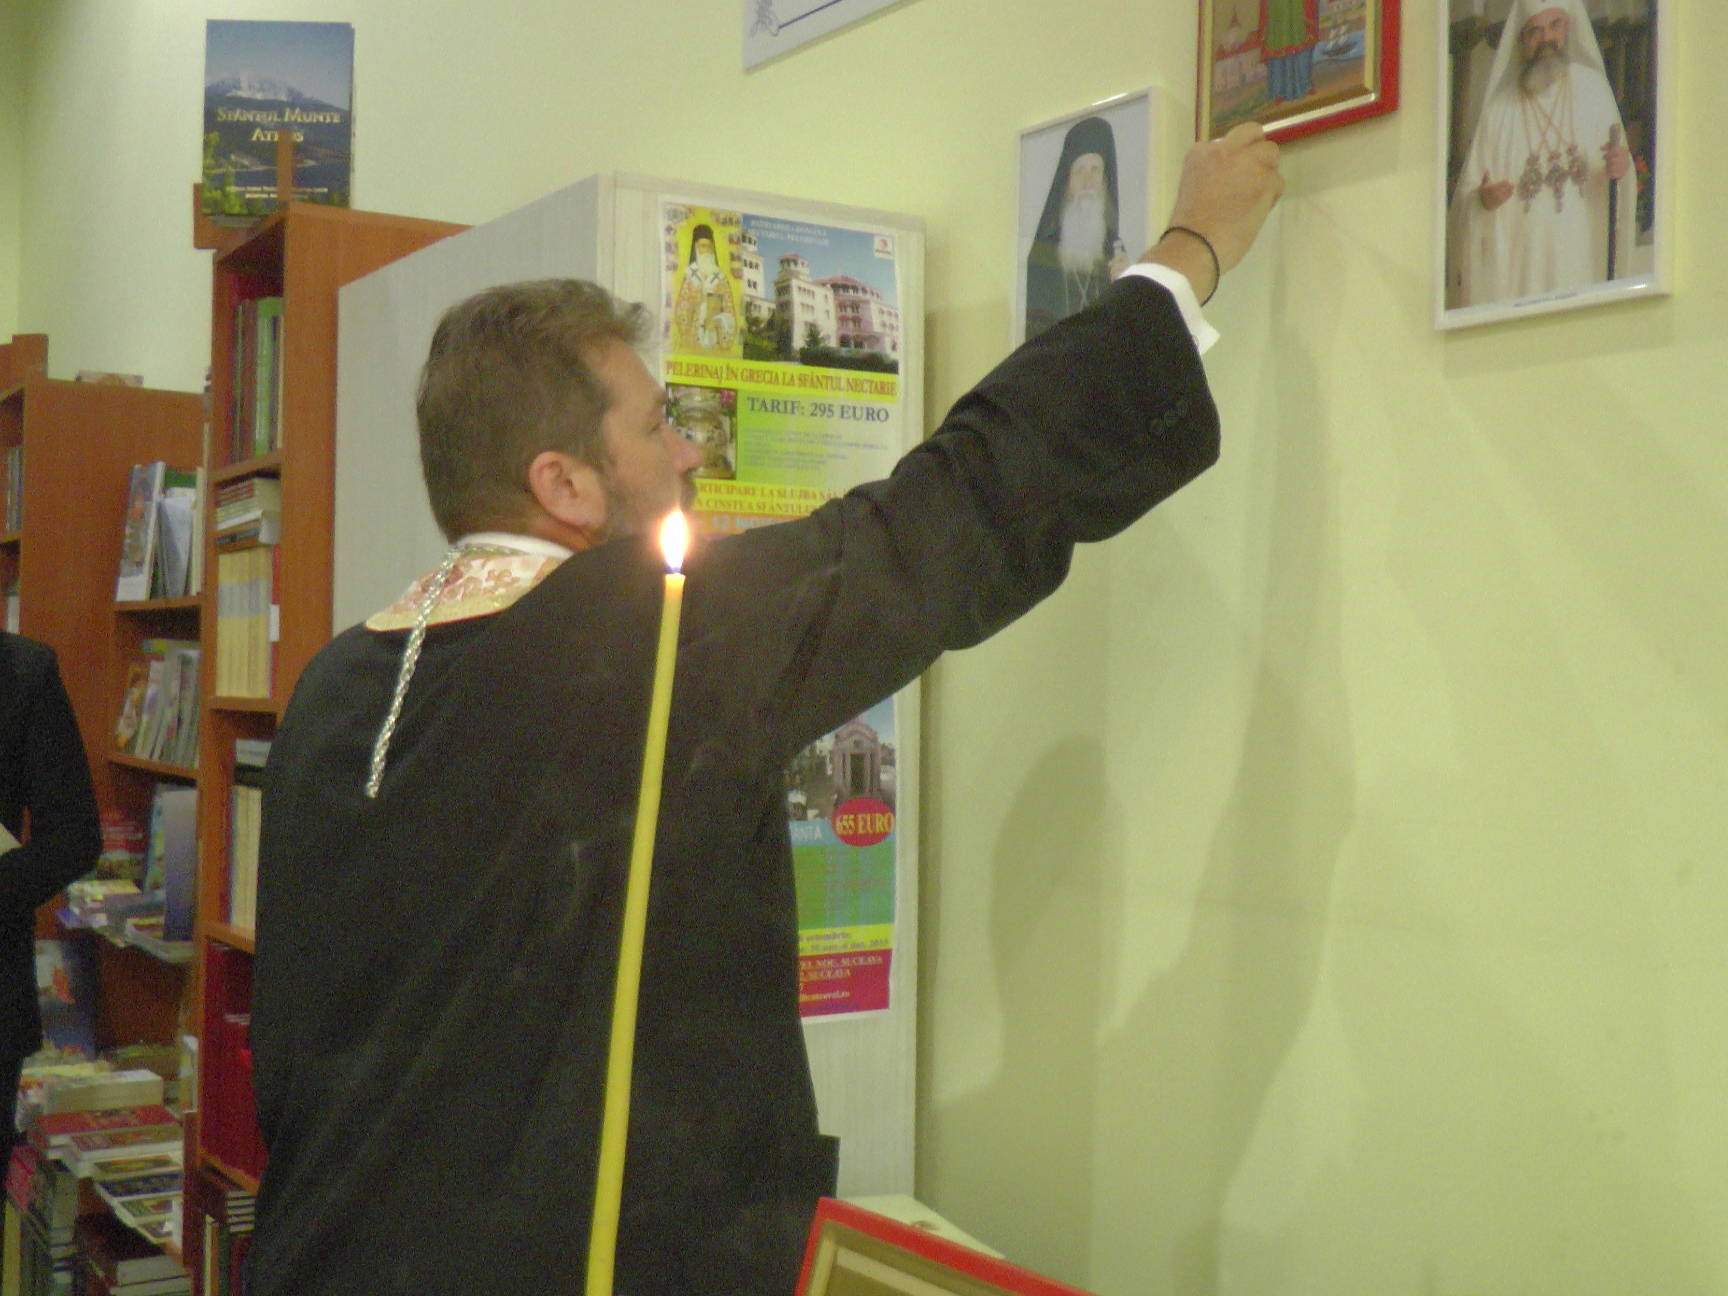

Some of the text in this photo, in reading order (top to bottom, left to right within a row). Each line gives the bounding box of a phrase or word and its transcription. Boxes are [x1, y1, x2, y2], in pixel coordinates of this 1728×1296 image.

[284, 107, 341, 123] MUNTE
[666, 361, 723, 384] PELERINAJ
[741, 368, 780, 386] GRECIA
[782, 371, 796, 387] LA
[846, 377, 898, 396] NECTARIE
[747, 397, 890, 423] TARIF: 295 EURO
[857, 812, 895, 834] EURO
